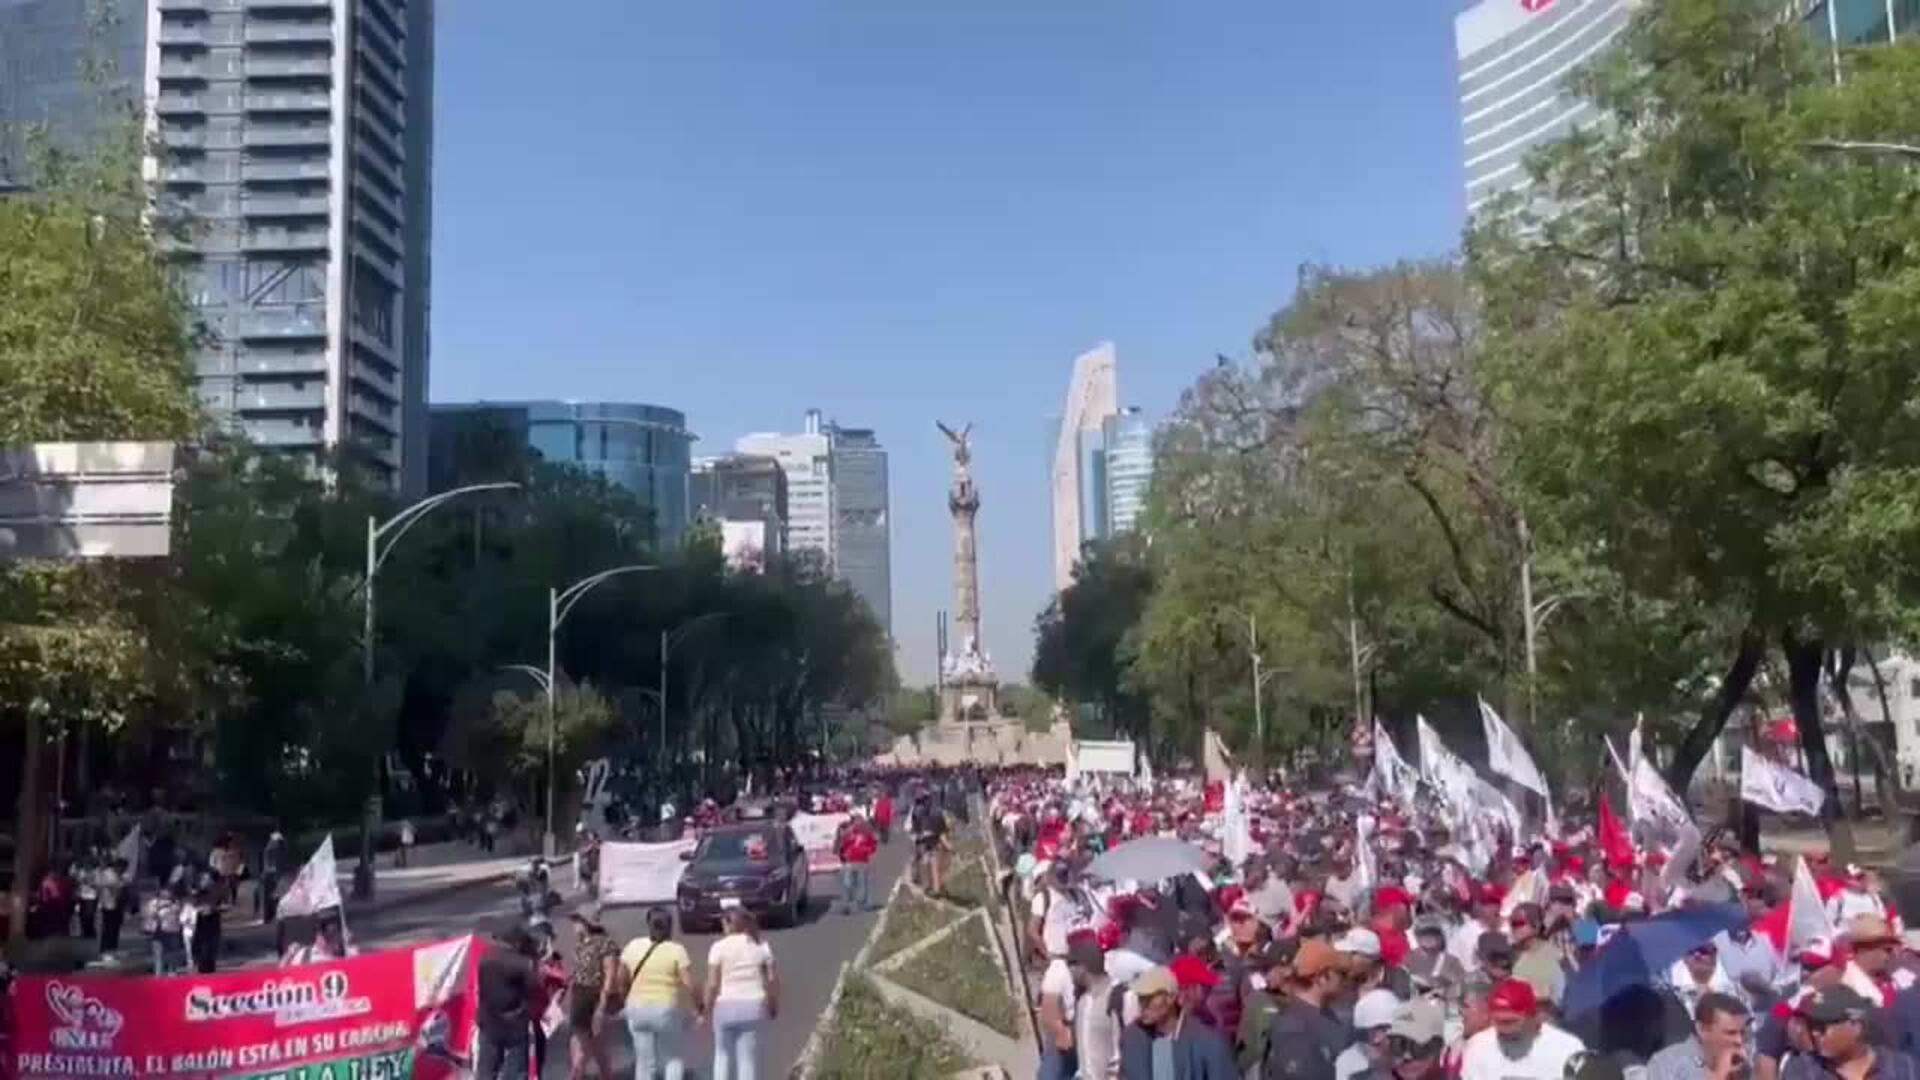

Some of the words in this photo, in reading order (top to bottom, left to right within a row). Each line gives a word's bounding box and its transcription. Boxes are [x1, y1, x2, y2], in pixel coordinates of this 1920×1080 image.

[187, 979, 317, 1020] Sección
[321, 970, 349, 1001] 9
[146, 1055, 167, 1073] EL
[172, 1046, 233, 1071] BALÓN
[285, 1035, 308, 1058] EN
[312, 1030, 335, 1053] SU
